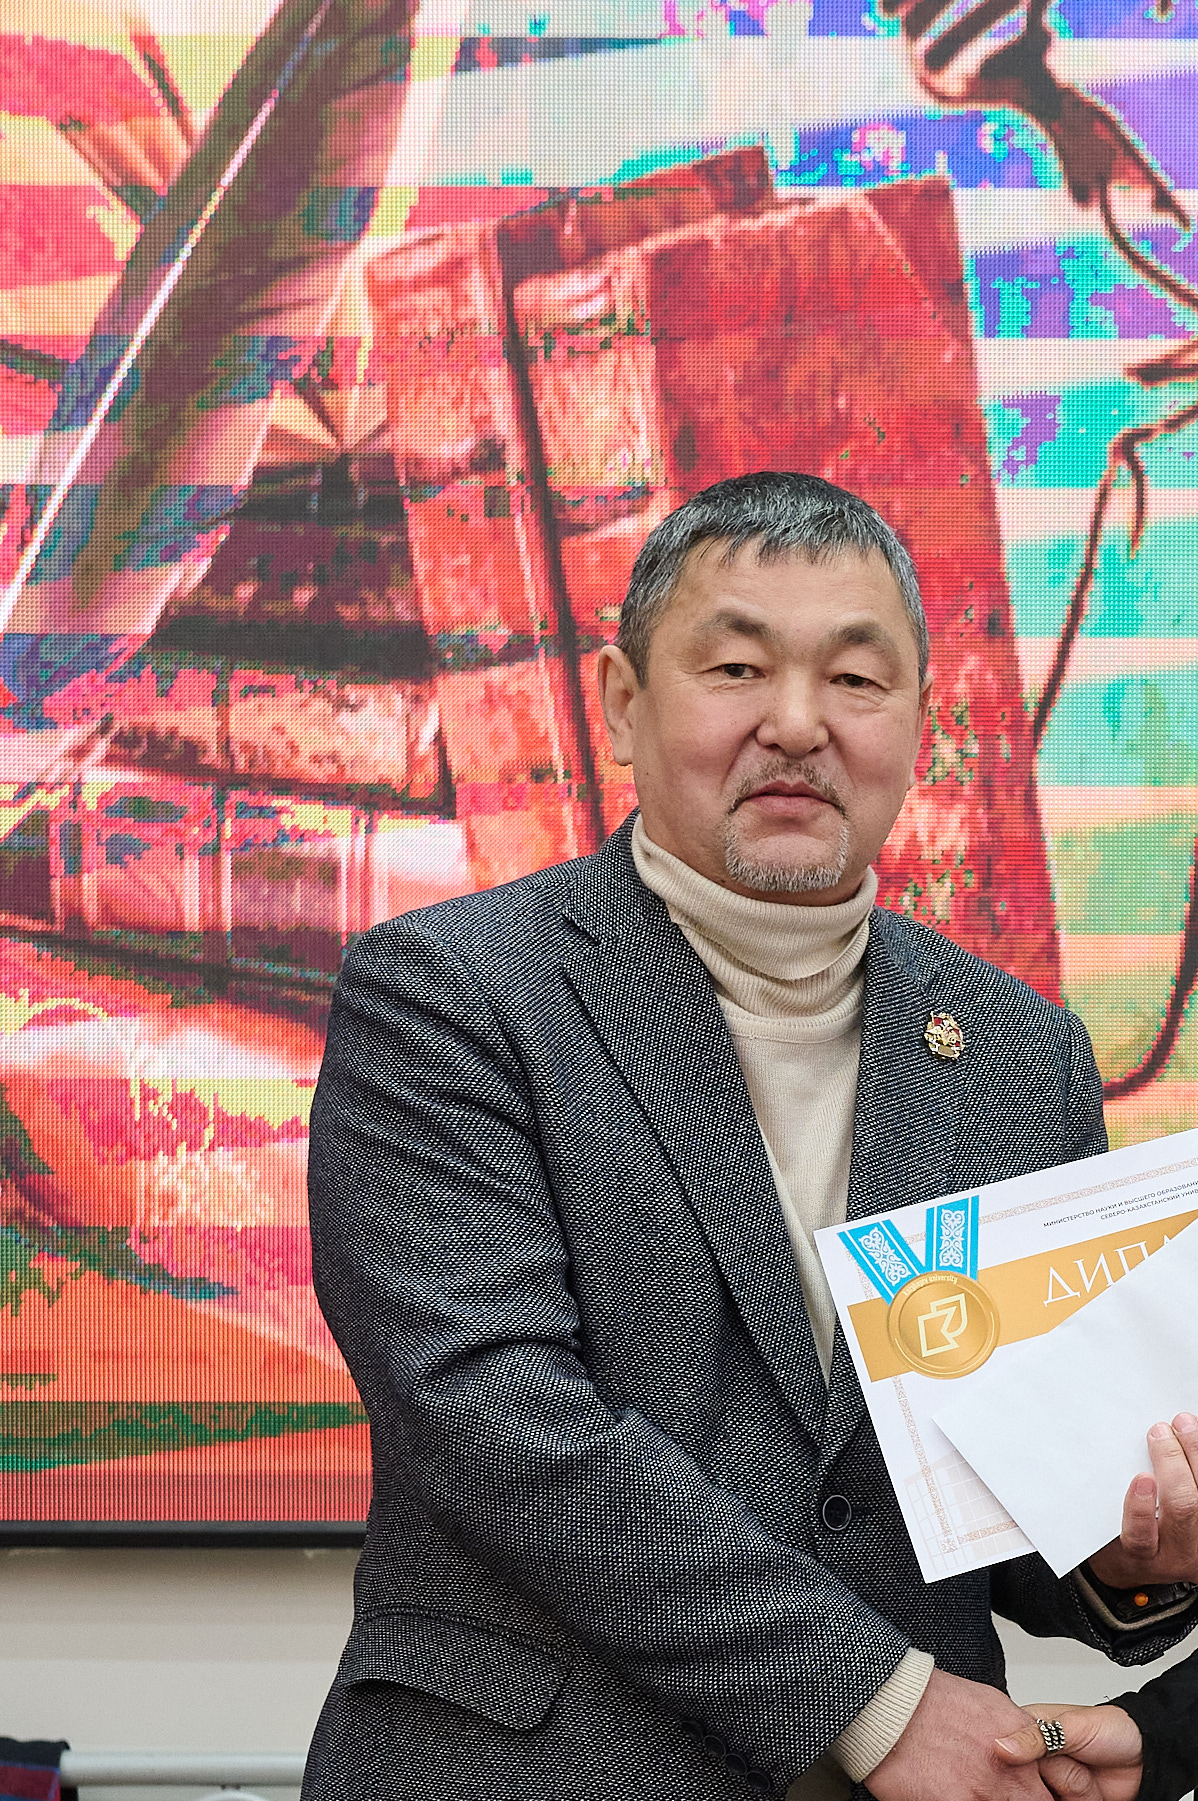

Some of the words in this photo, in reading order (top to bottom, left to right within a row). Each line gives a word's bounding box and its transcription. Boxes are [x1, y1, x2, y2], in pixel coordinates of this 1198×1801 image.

[1043, 1209, 1095, 1228] МИНИСТЕРСТВО
[1096, 1202, 1118, 1214] НАУКИ
[1125, 1192, 1156, 1206] ВЫСШЕГО
[1100, 1192, 1181, 1220] СЕВЕРО-КАЗАХСТАНСКИЙ
[1043, 1234, 1171, 1308] ДИП
